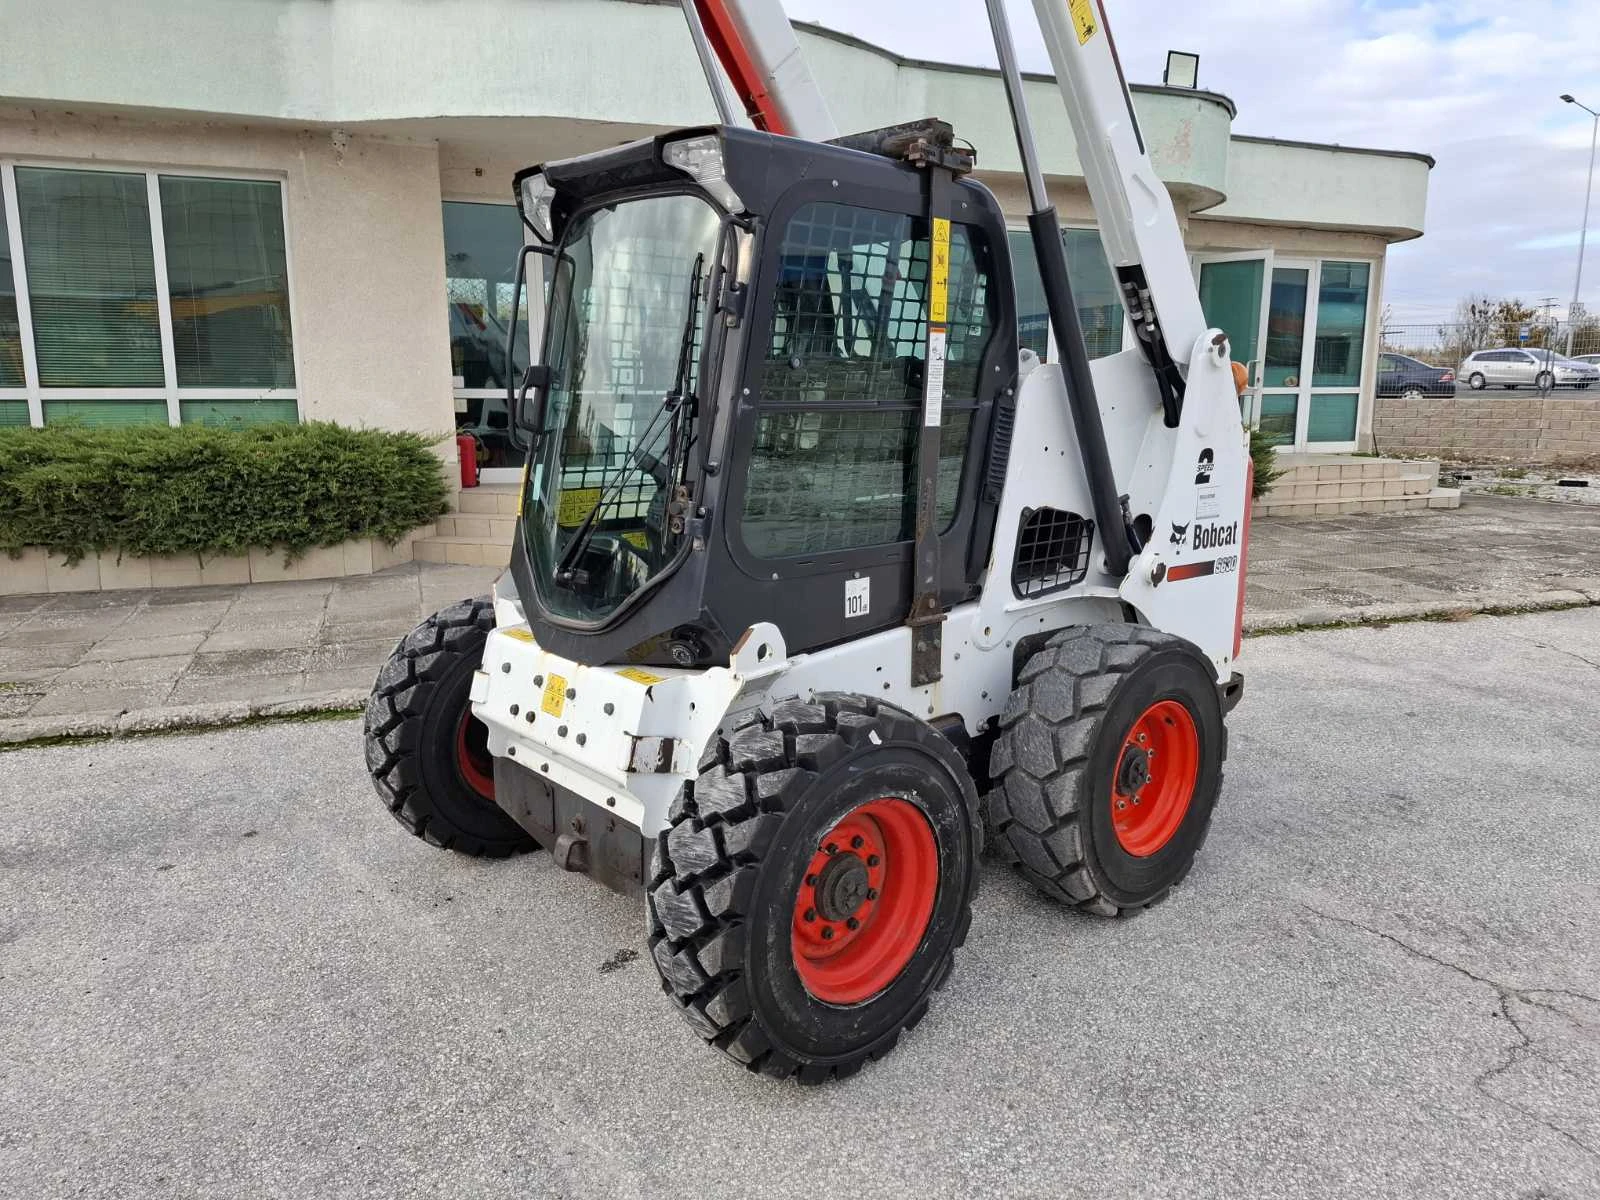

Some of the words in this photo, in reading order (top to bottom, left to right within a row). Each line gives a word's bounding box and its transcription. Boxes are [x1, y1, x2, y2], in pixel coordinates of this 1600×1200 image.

[1196, 463, 1214, 473] SPEED
[1192, 521, 1237, 550] Bobcat
[847, 594, 862, 614] 101
